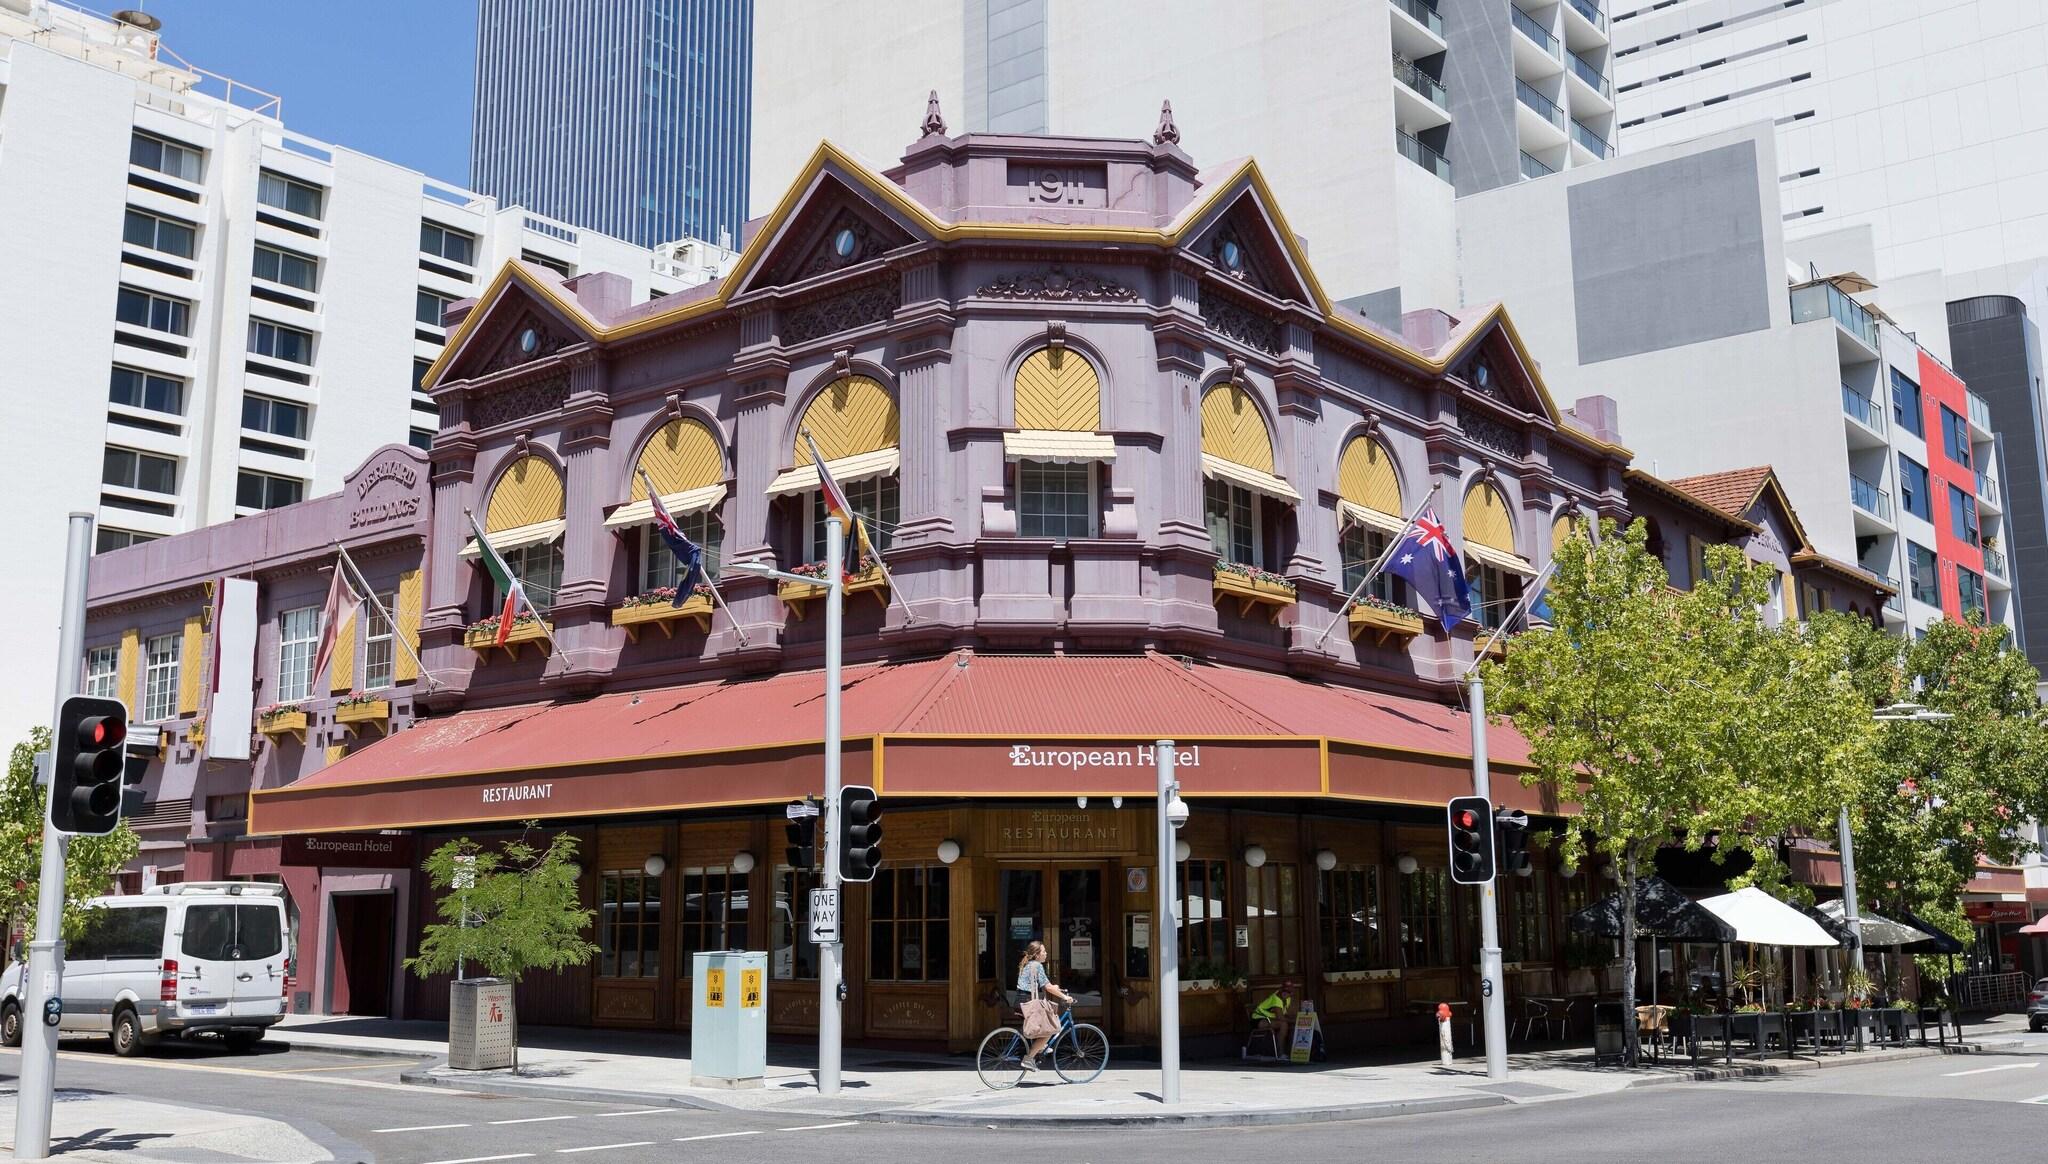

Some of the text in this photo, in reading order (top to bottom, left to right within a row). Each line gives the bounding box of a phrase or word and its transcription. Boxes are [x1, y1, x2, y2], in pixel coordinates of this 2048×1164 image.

[1028, 168, 1084, 202] 1911
[350, 496, 420, 528] BUILDINGS
[1009, 745, 1199, 770] European Htel
[483, 784, 552, 802] RESTAURANT
[1032, 811, 1090, 824] European
[1003, 828, 1119, 840] RESTAURANT
[306, 838, 392, 853] European Hotel
[814, 895, 835, 906] ONE
[813, 911, 835, 922] WAY
